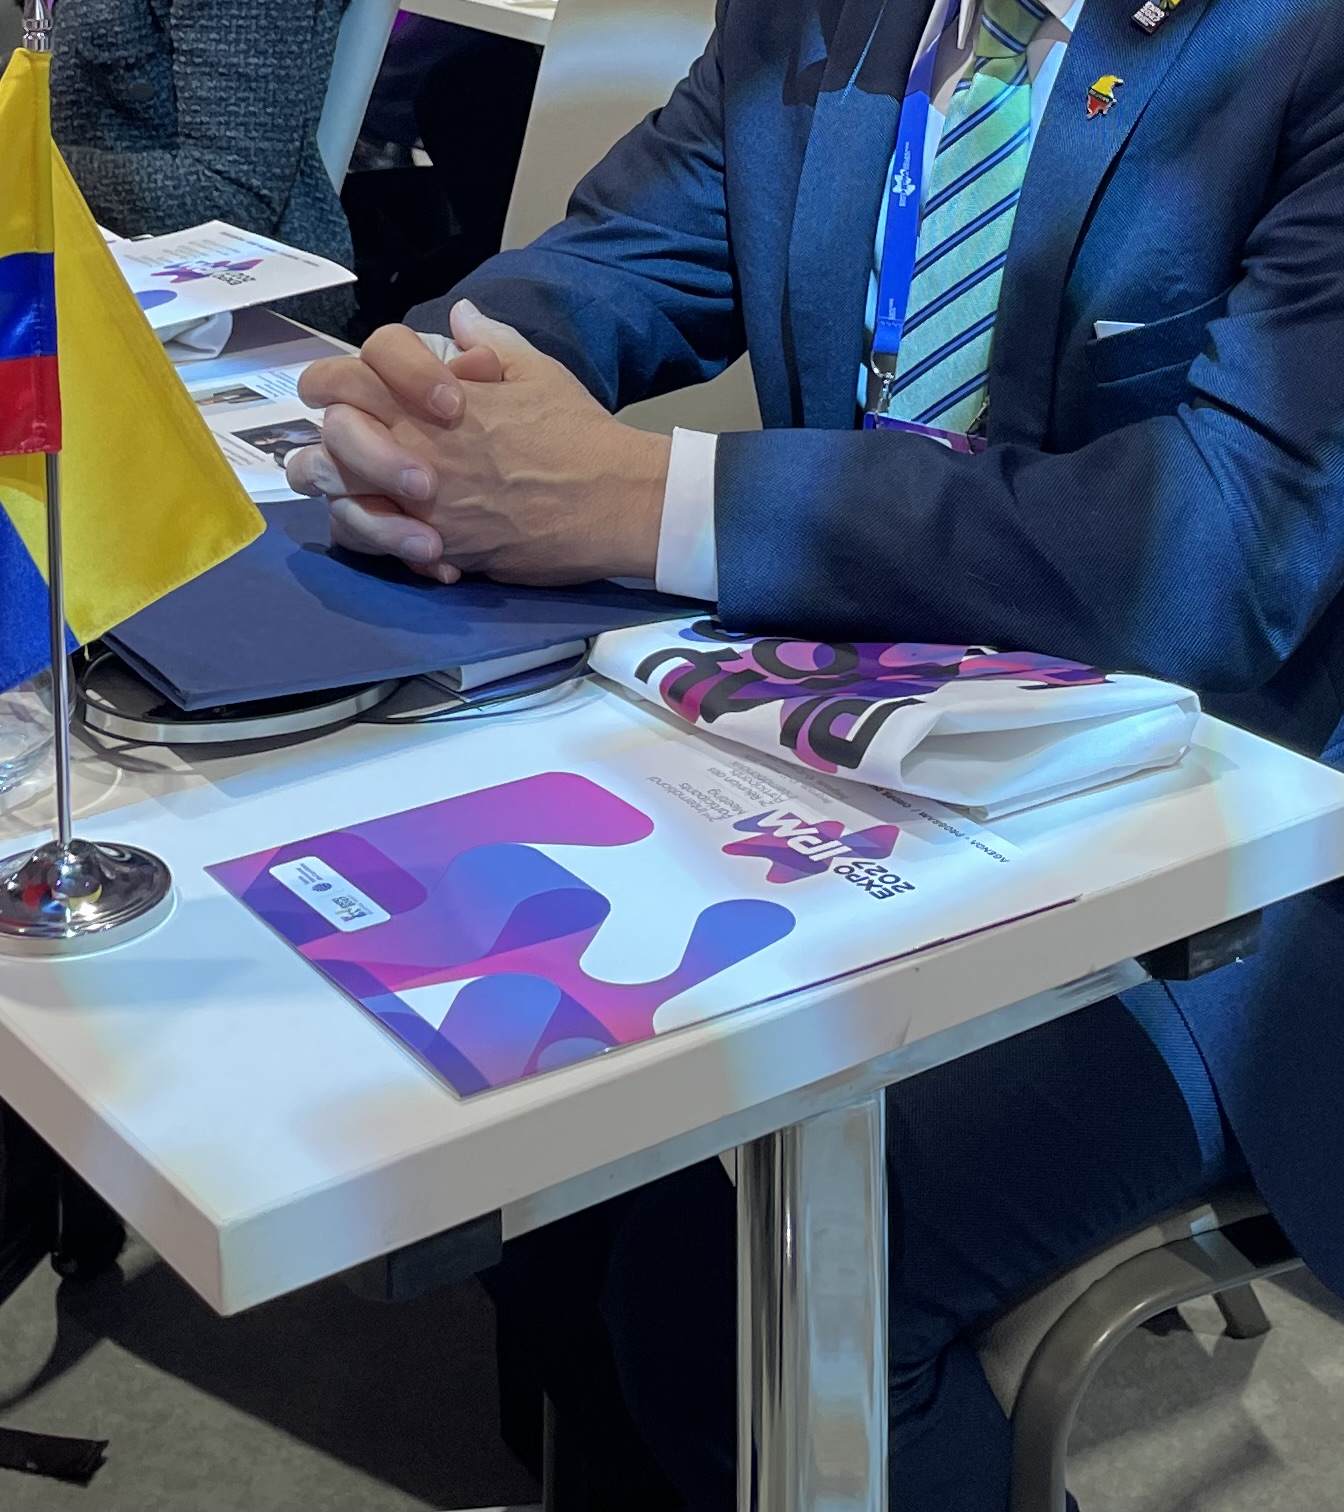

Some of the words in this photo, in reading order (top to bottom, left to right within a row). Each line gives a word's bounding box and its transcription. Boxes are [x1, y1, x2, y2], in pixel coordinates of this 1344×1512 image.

[757, 808, 852, 861] IPM
[919, 811, 965, 837] PROGRAM
[970, 839, 1010, 863] AGENDA
[833, 865, 895, 899] EXPO
[852, 861, 915, 893] 2027
